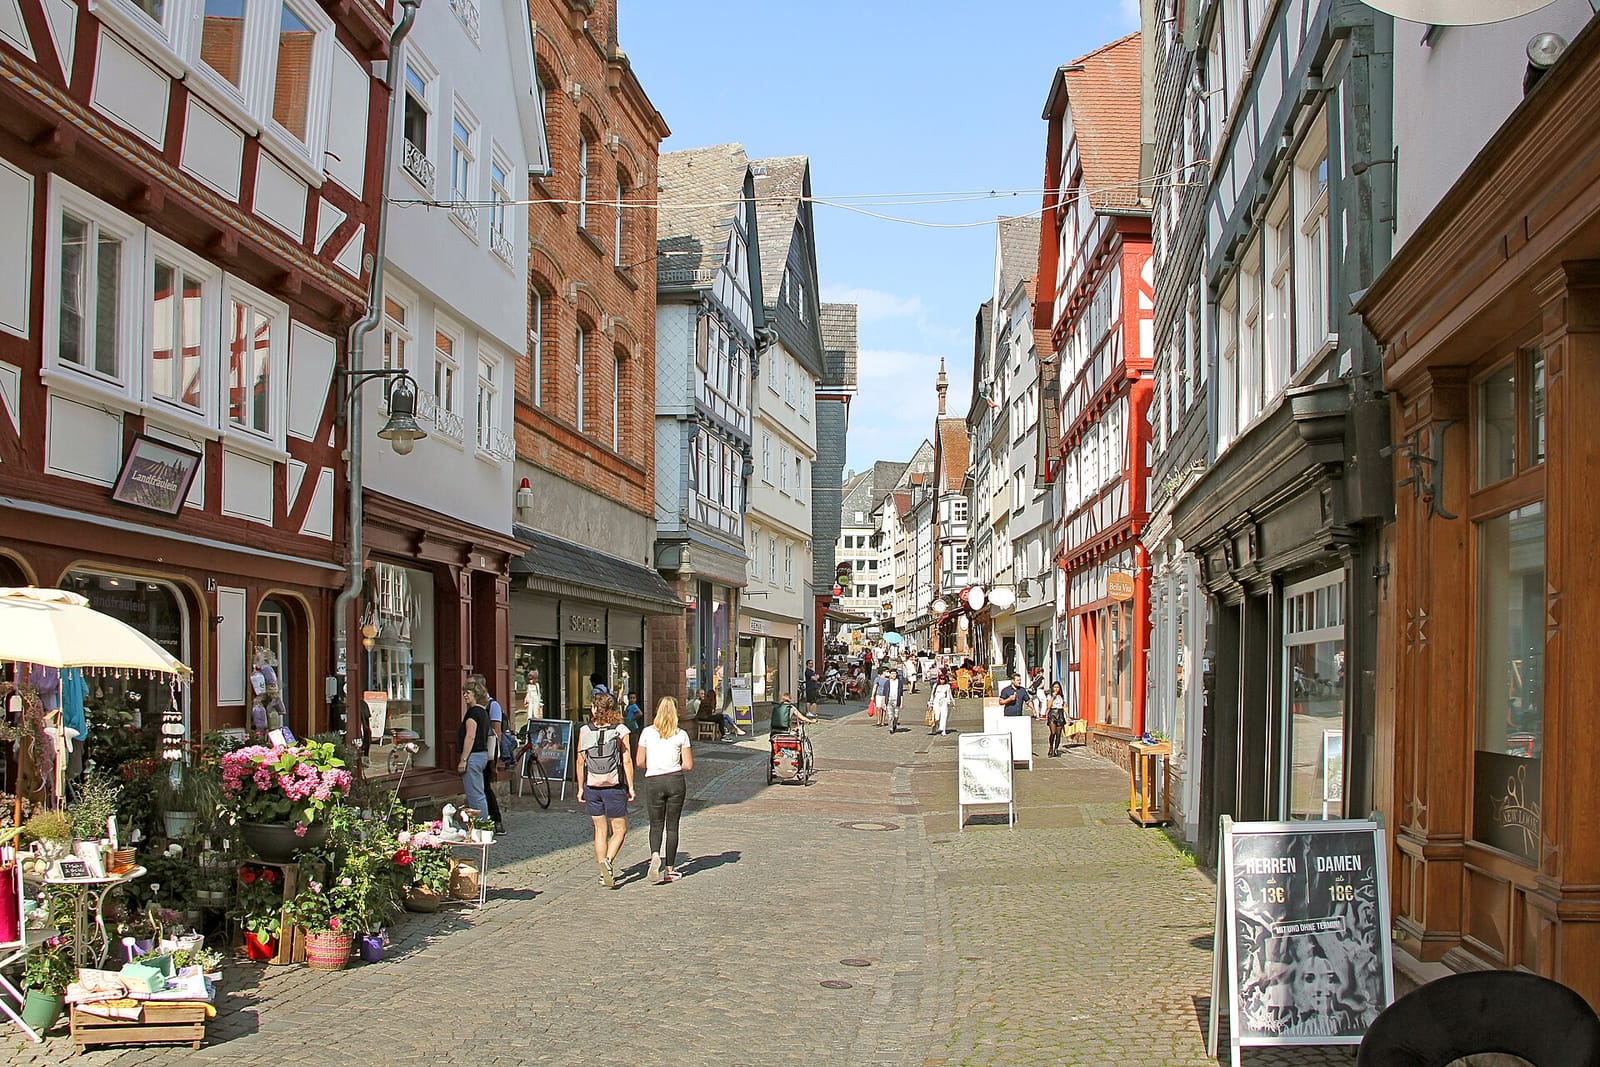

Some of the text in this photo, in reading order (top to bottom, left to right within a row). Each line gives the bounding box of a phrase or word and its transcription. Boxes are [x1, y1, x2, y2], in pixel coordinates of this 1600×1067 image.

[1246, 857, 1297, 874] HERREN
[1317, 855, 1362, 873] DAMEN
[1260, 887, 1286, 904] 13€
[1328, 885, 1354, 902] 18€
[1300, 923, 1316, 932] OHNE
